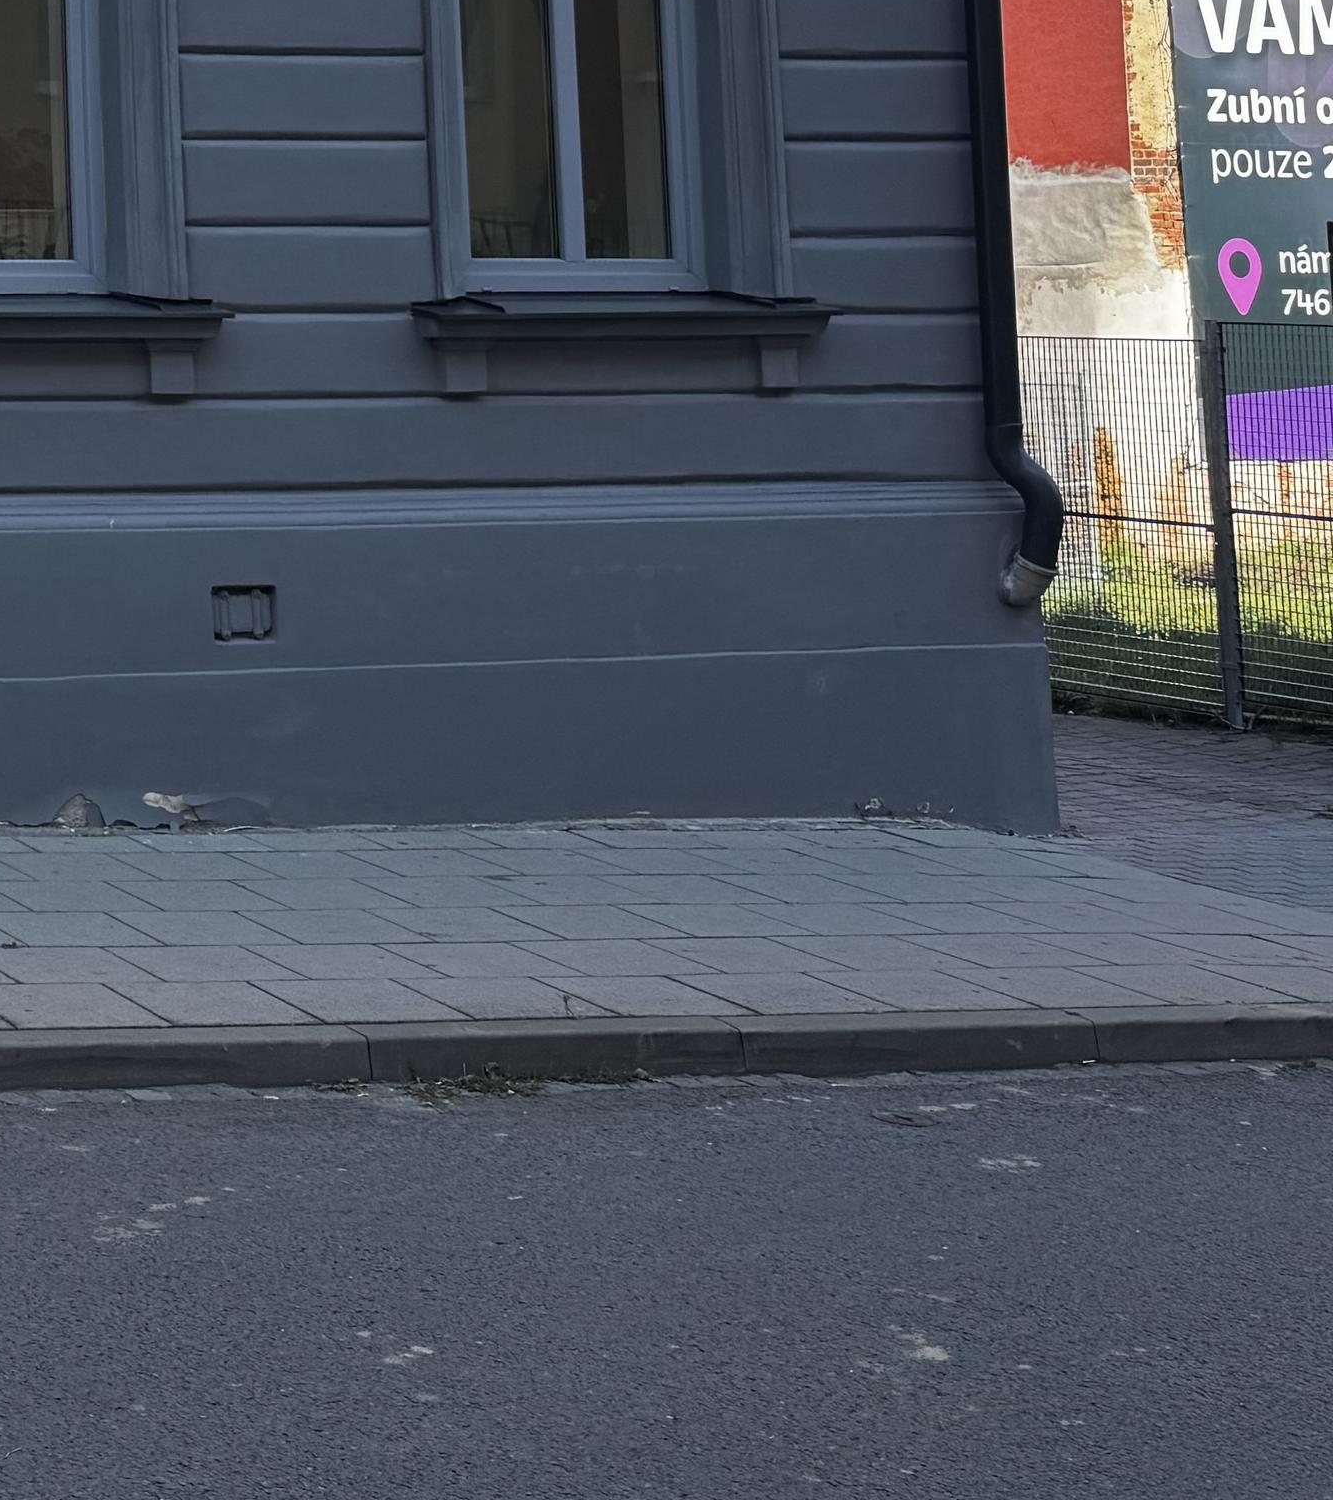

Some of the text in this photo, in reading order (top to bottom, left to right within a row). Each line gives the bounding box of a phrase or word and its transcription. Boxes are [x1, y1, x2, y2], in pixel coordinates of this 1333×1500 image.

[1206, 86, 1306, 124] Zubní
[1211, 148, 1313, 184] pouze
[1281, 289, 1331, 316] 746
